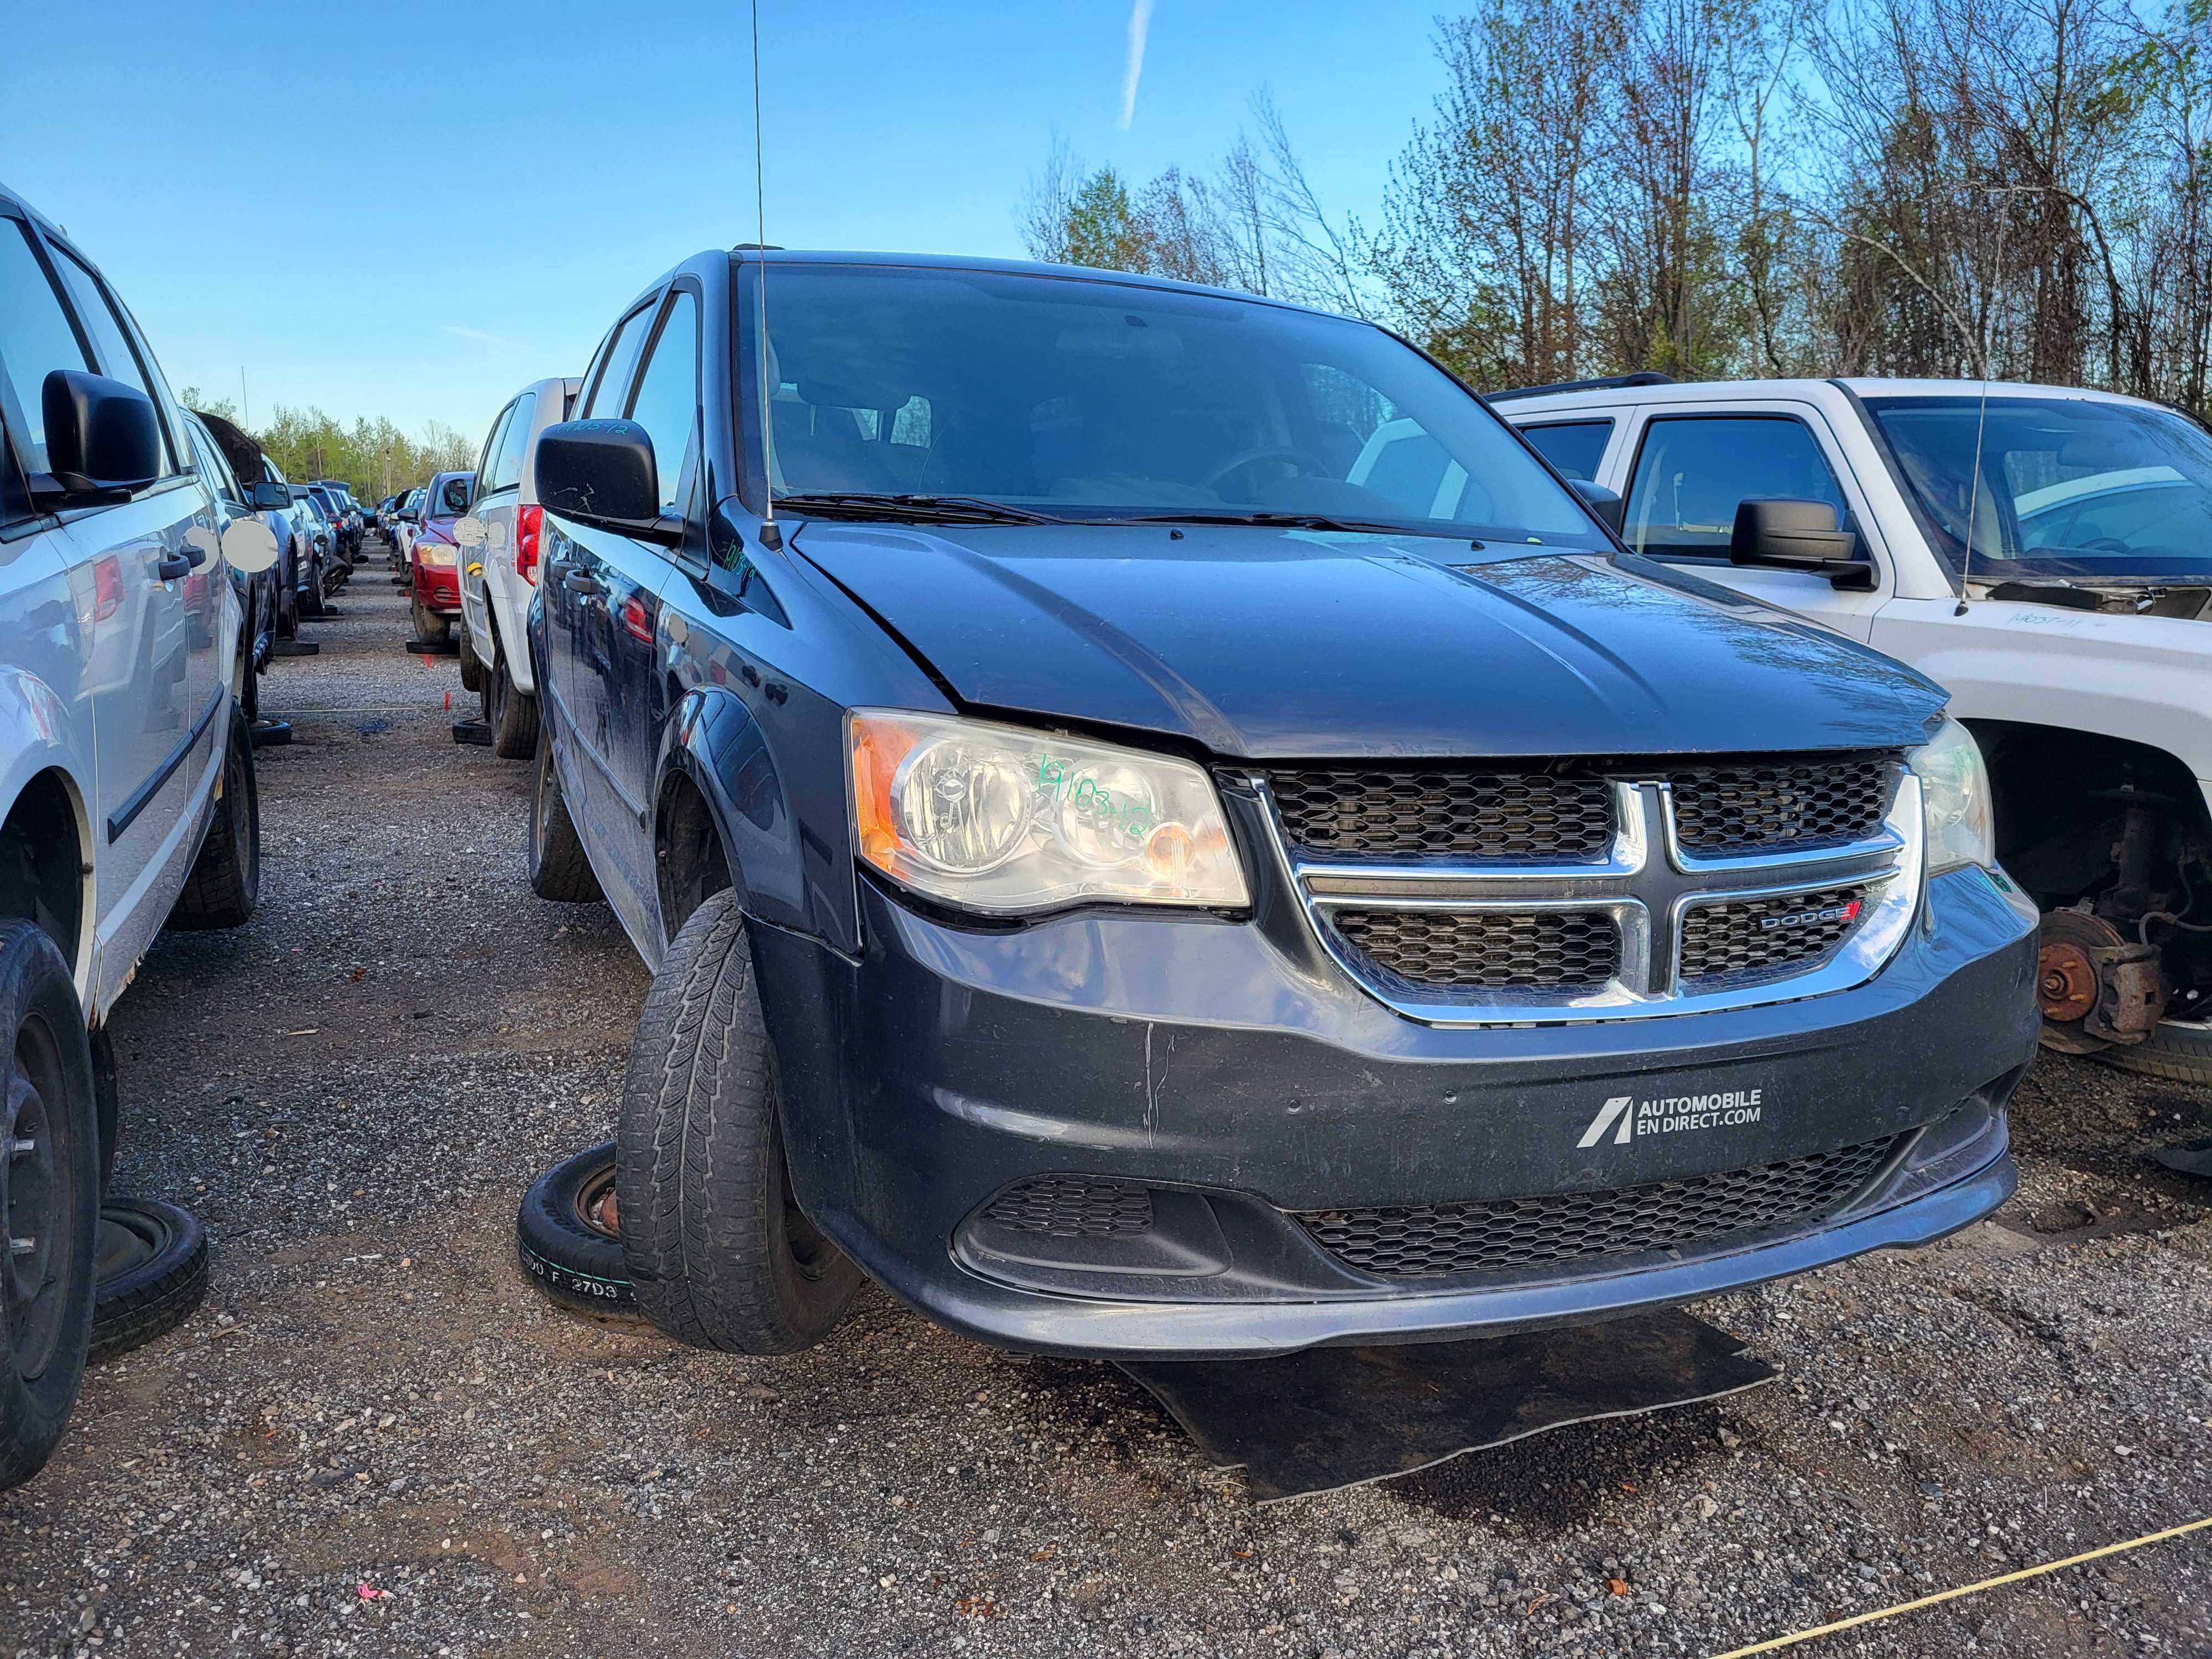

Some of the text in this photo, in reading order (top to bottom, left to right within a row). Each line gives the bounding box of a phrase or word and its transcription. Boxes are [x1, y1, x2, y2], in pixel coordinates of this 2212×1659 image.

[1761, 907, 1849, 929] DODGE
[1638, 1089, 1762, 1118] AUTOMOBILE
[1637, 1107, 1761, 1135] EN DIRECT.COM
